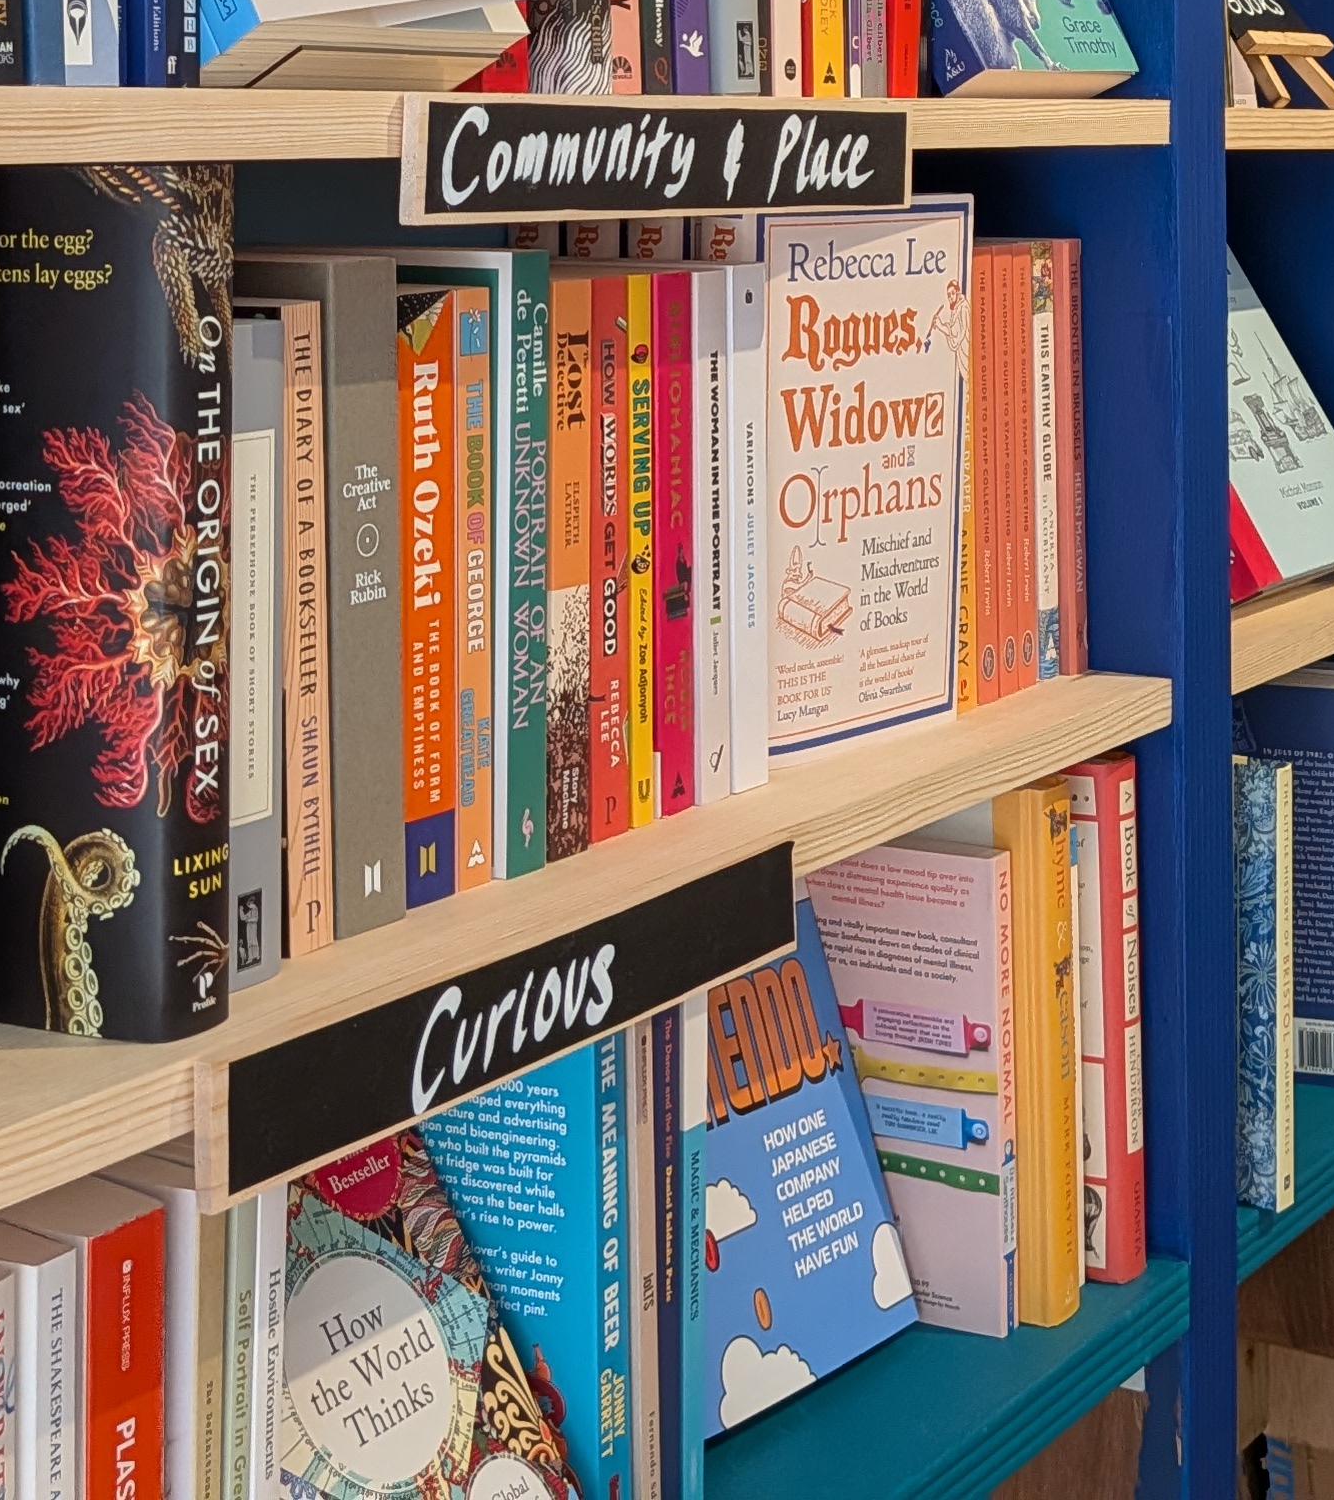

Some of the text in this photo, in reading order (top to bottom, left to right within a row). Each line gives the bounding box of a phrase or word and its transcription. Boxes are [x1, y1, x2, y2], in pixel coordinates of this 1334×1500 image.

[1062, 15, 1104, 36] Grace
[1065, 35, 1118, 59] Timothy
[440, 104, 876, 207] Community & Place
[786, 237, 948, 285] Rebecca Lee
[780, 380, 945, 453] Widows
[354, 464, 378, 480] The
[881, 449, 907, 472] and
[341, 475, 392, 500] Creative
[356, 495, 378, 511] Act
[413, 360, 441, 612] Ruth Ozeki
[778, 462, 945, 546] Orphans
[193, 315, 223, 797] On THE ORIGIN of SEX
[354, 570, 382, 587] Rick
[349, 584, 387, 606] Rubin
[171, 842, 230, 877] LIXING
[187, 873, 223, 899] SUN
[411, 943, 616, 1115] Curious
[763, 1107, 830, 1152] HOW ONE
[770, 1130, 838, 1177] JAPANESE
[774, 1156, 843, 1203] COMPANY
[780, 1186, 835, 1228] HELPED
[788, 1199, 865, 1252] THE WORLD
[793, 1233, 861, 1279] HAVE FUN
[317, 1299, 385, 1357] How
[309, 1316, 437, 1420] the World
[340, 1376, 437, 1452] Thinks
